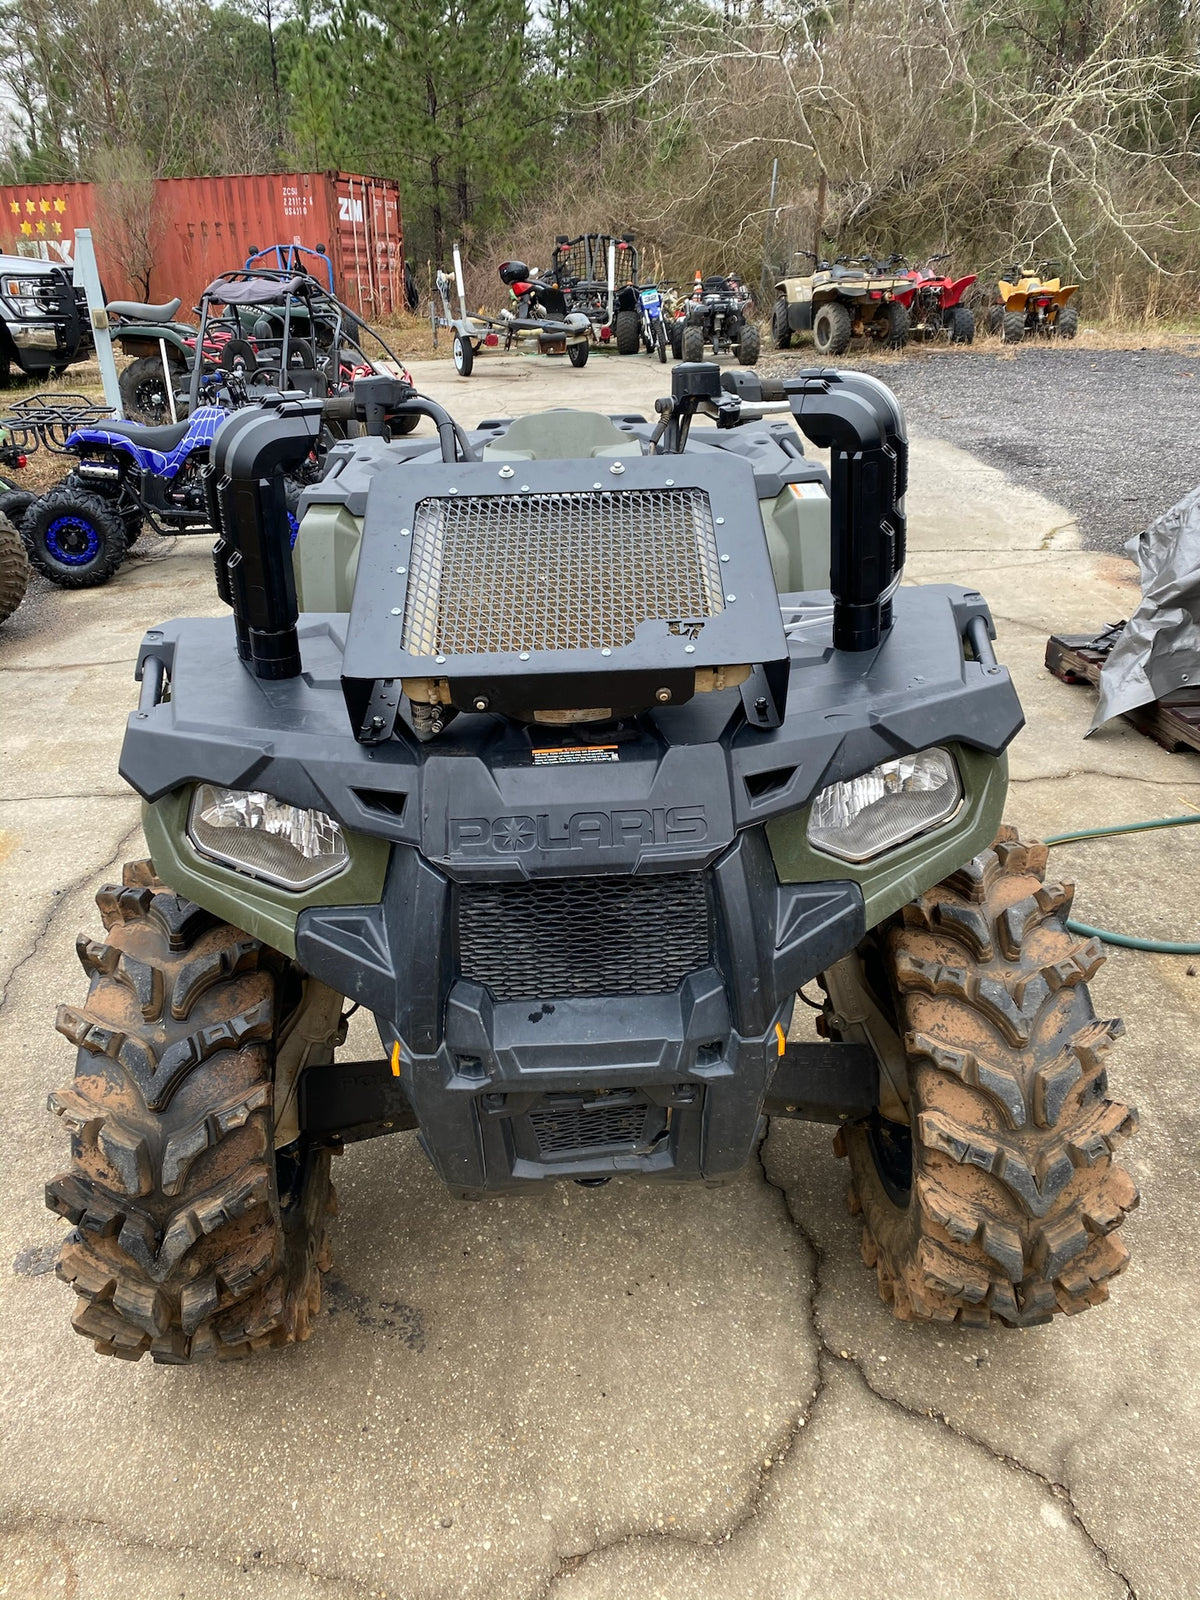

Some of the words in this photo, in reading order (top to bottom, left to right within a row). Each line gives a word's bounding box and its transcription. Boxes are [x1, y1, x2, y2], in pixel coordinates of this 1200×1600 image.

[338, 197, 363, 222] ZIM
[644, 295, 657, 303] 32
[448, 804, 709, 855] POLARIS
